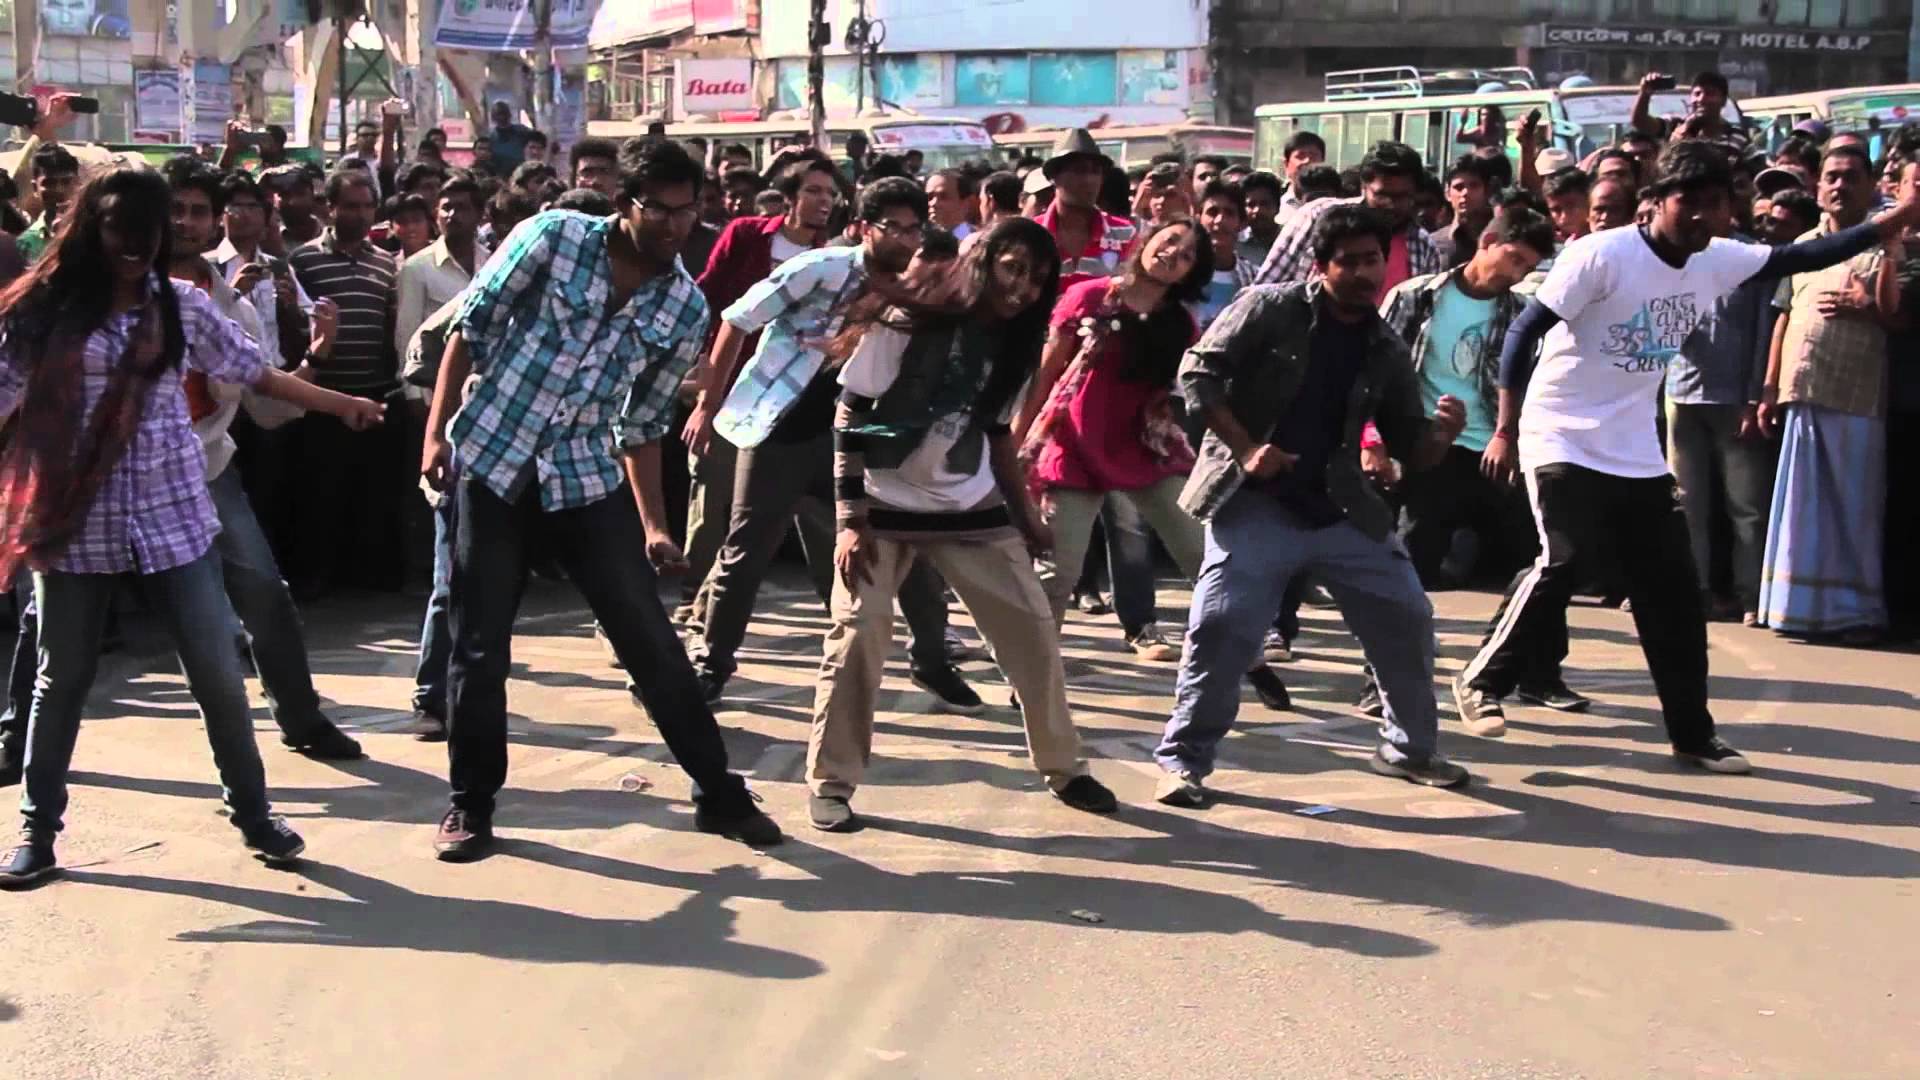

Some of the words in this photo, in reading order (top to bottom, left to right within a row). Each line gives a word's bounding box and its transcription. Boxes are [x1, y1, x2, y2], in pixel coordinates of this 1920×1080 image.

[1548, 27, 1630, 43] হোটেল
[1740, 33, 1809, 49] HOTEL
[685, 78, 746, 96] Bata
